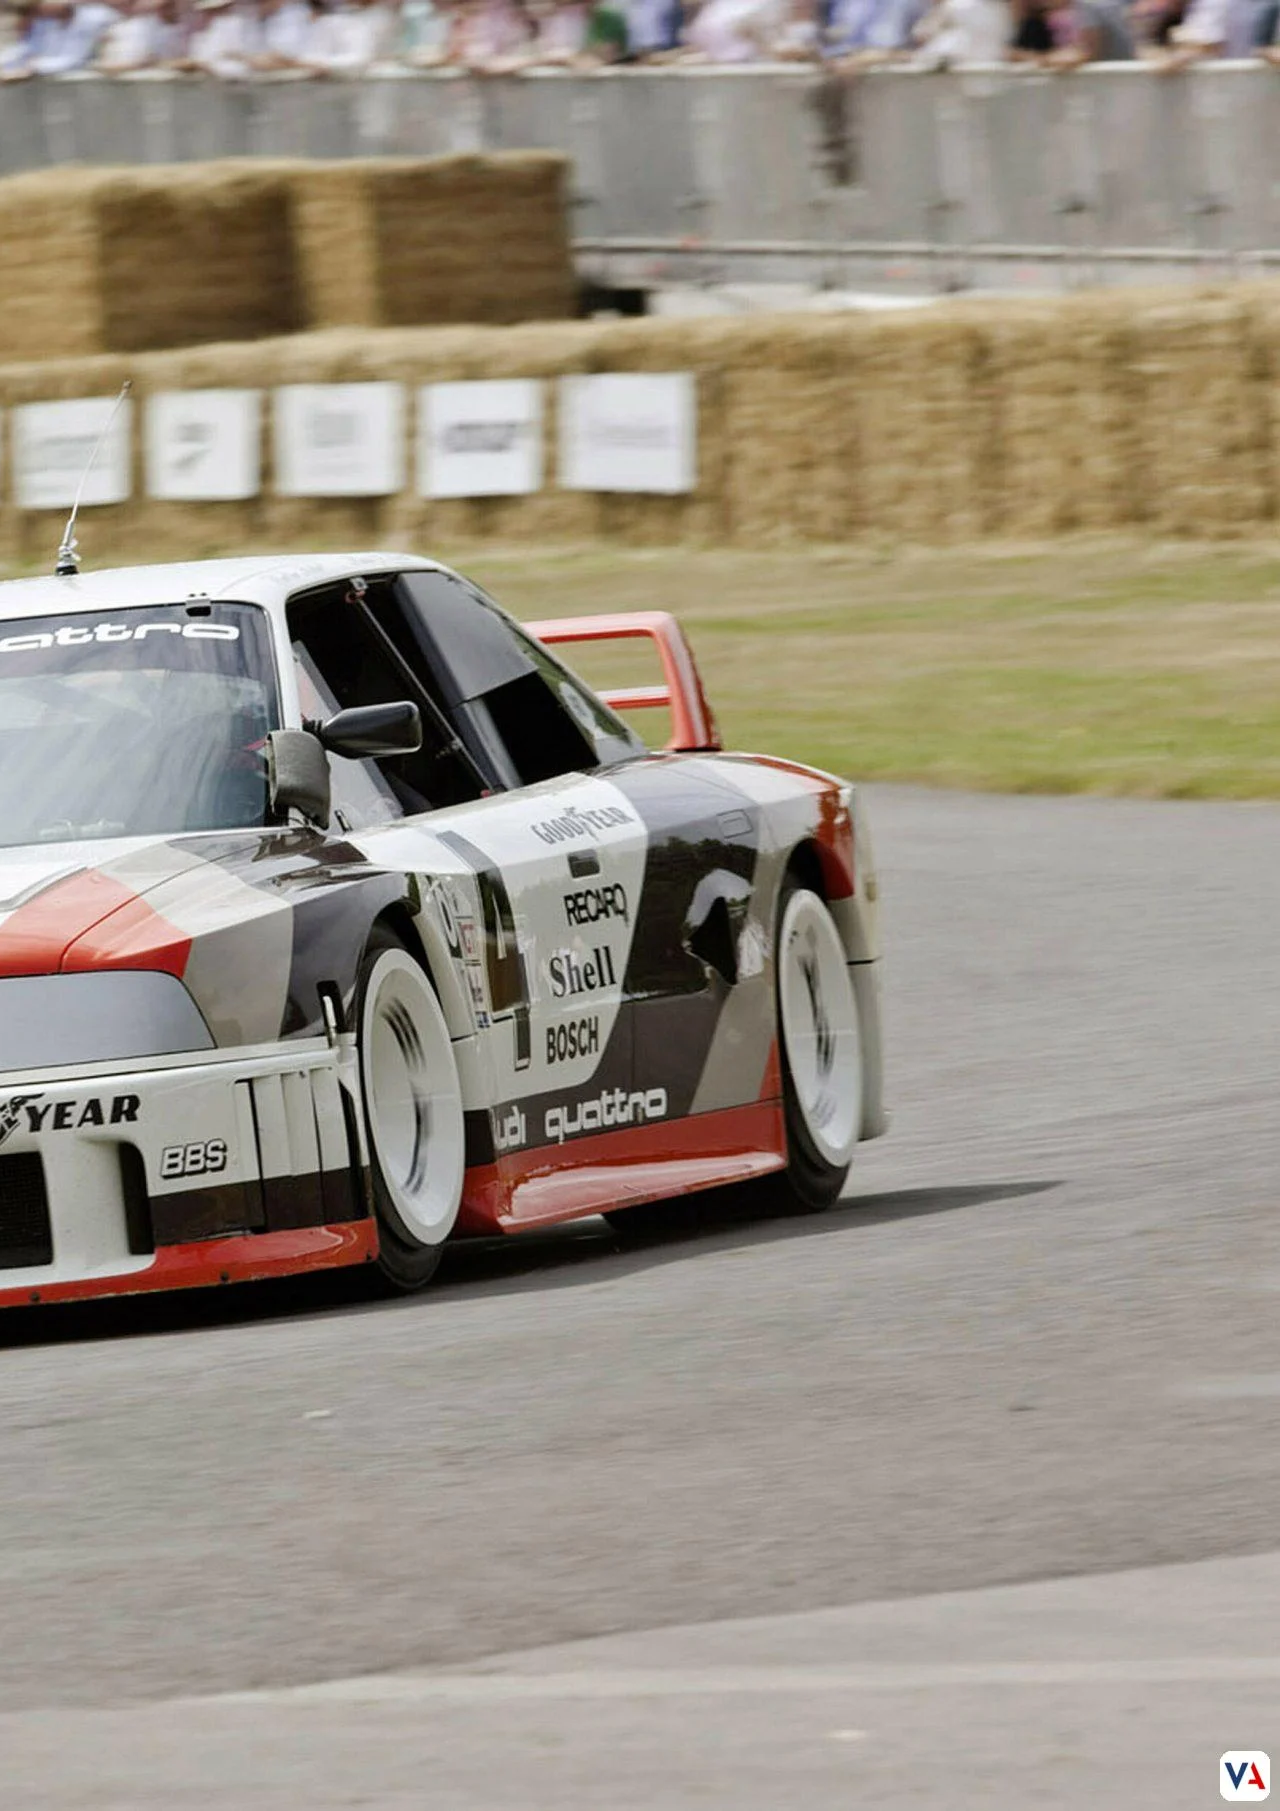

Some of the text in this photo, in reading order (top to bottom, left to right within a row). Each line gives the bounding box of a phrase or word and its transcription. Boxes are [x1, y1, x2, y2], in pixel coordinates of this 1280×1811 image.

[531, 806, 635, 843] GOODYEAR
[549, 945, 617, 998] Shell
[546, 1015, 599, 1064] BOSCH
[545, 1087, 667, 1145] quattro
[160, 1140, 227, 1179] BBS
